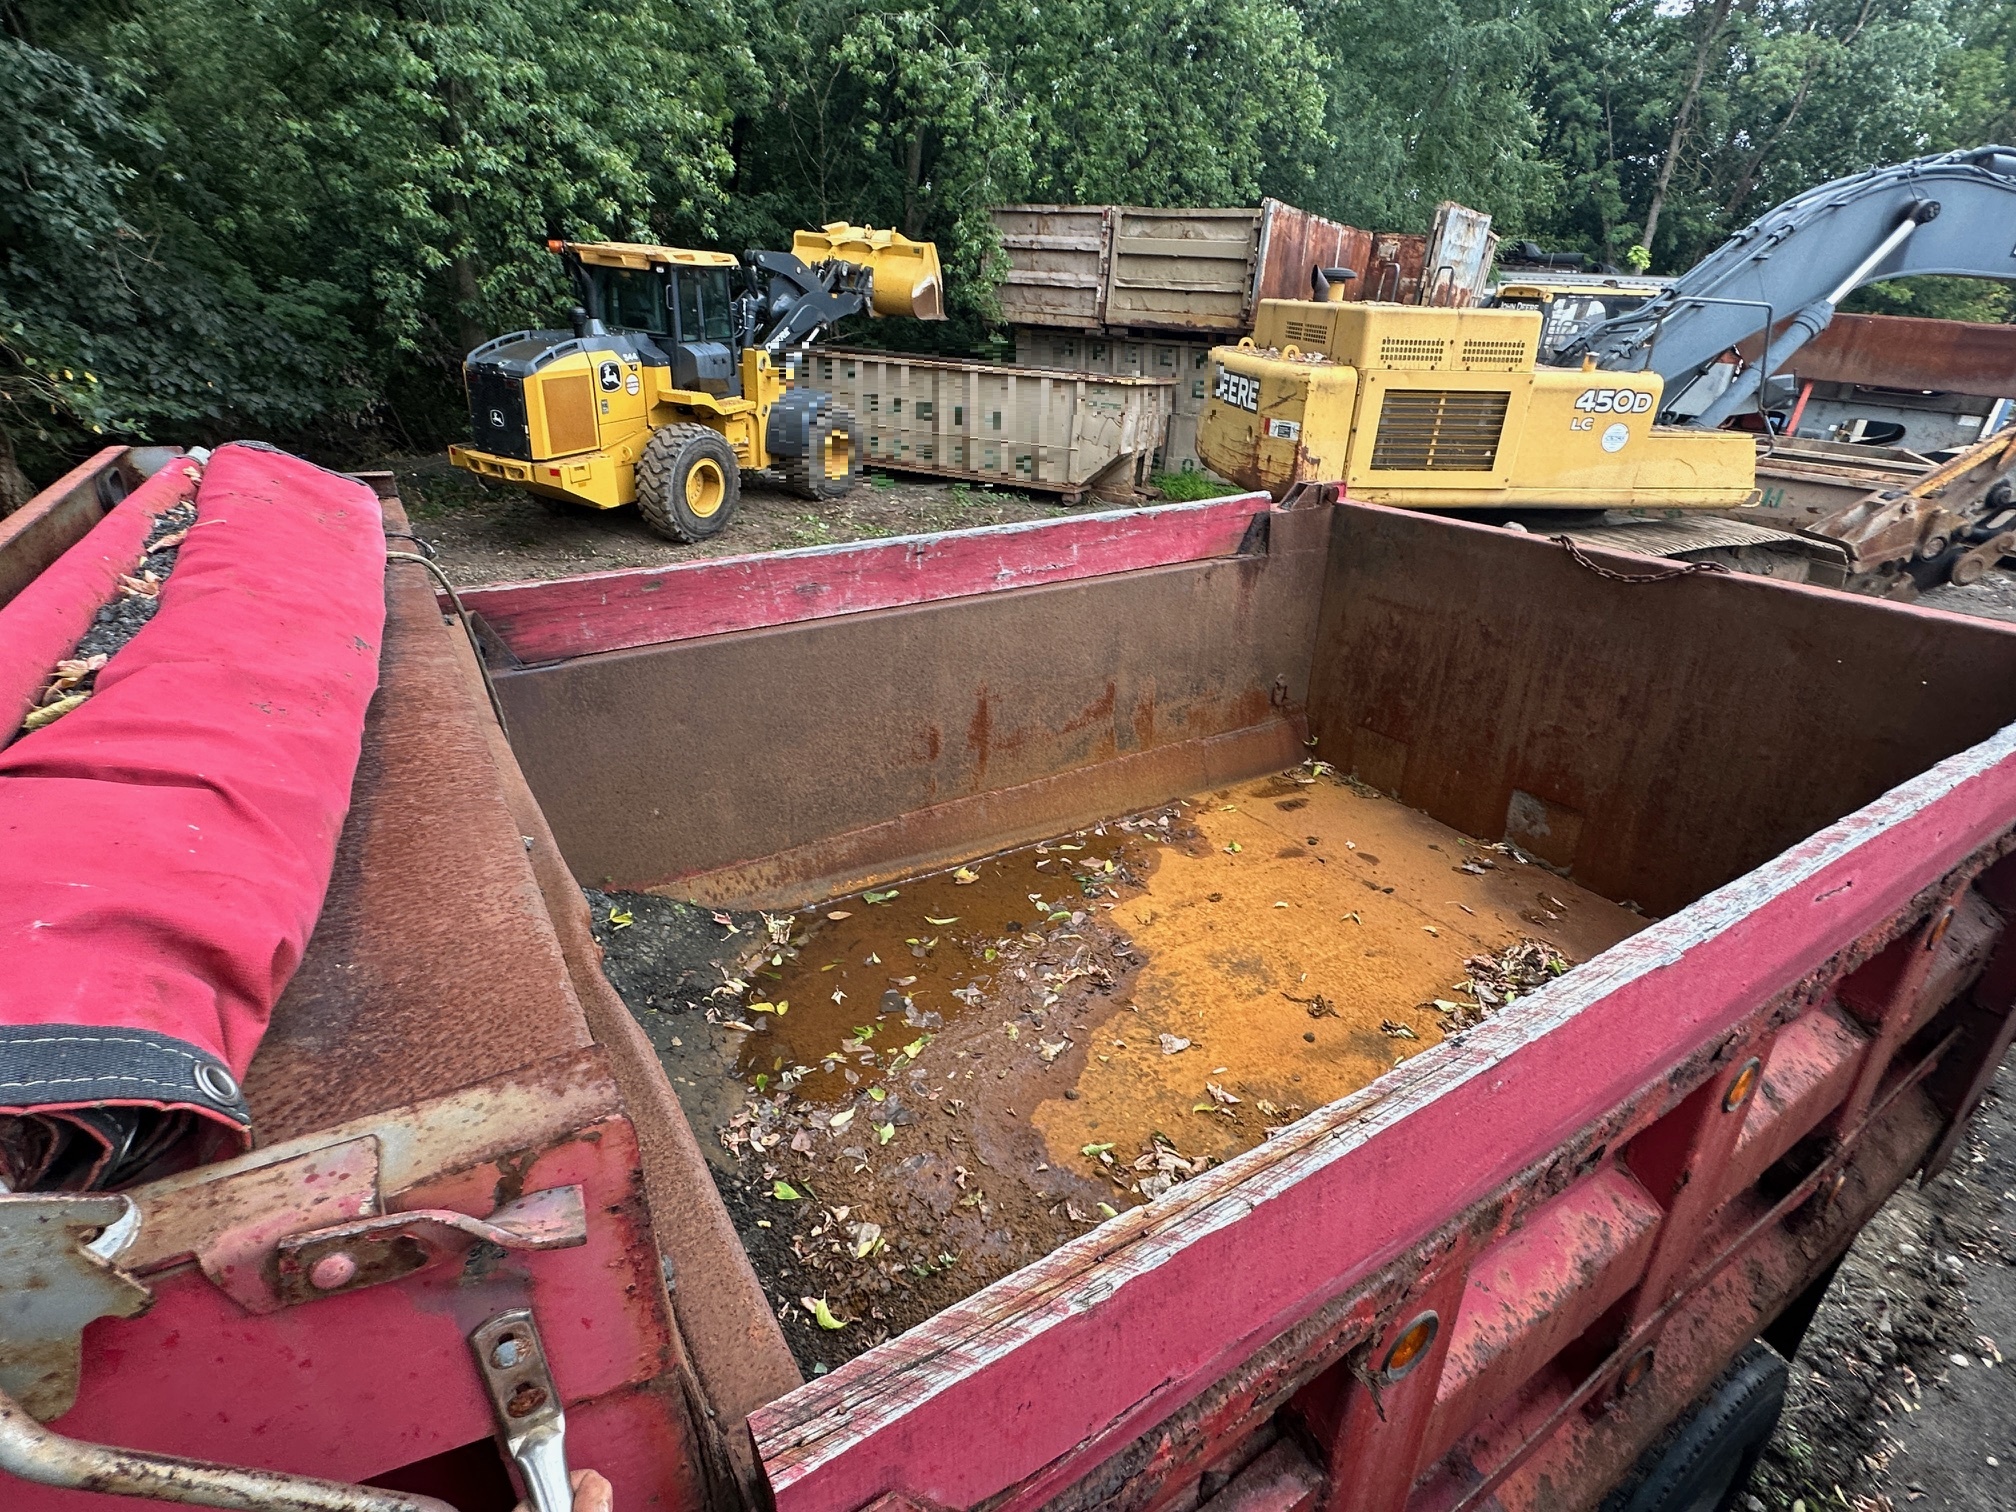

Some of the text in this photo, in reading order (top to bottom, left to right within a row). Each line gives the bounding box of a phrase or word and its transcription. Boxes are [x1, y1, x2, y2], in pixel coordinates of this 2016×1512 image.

[1215, 365, 1260, 412] EERE
[1574, 388, 1654, 414] 450D
[1570, 417, 1594, 431] LC
